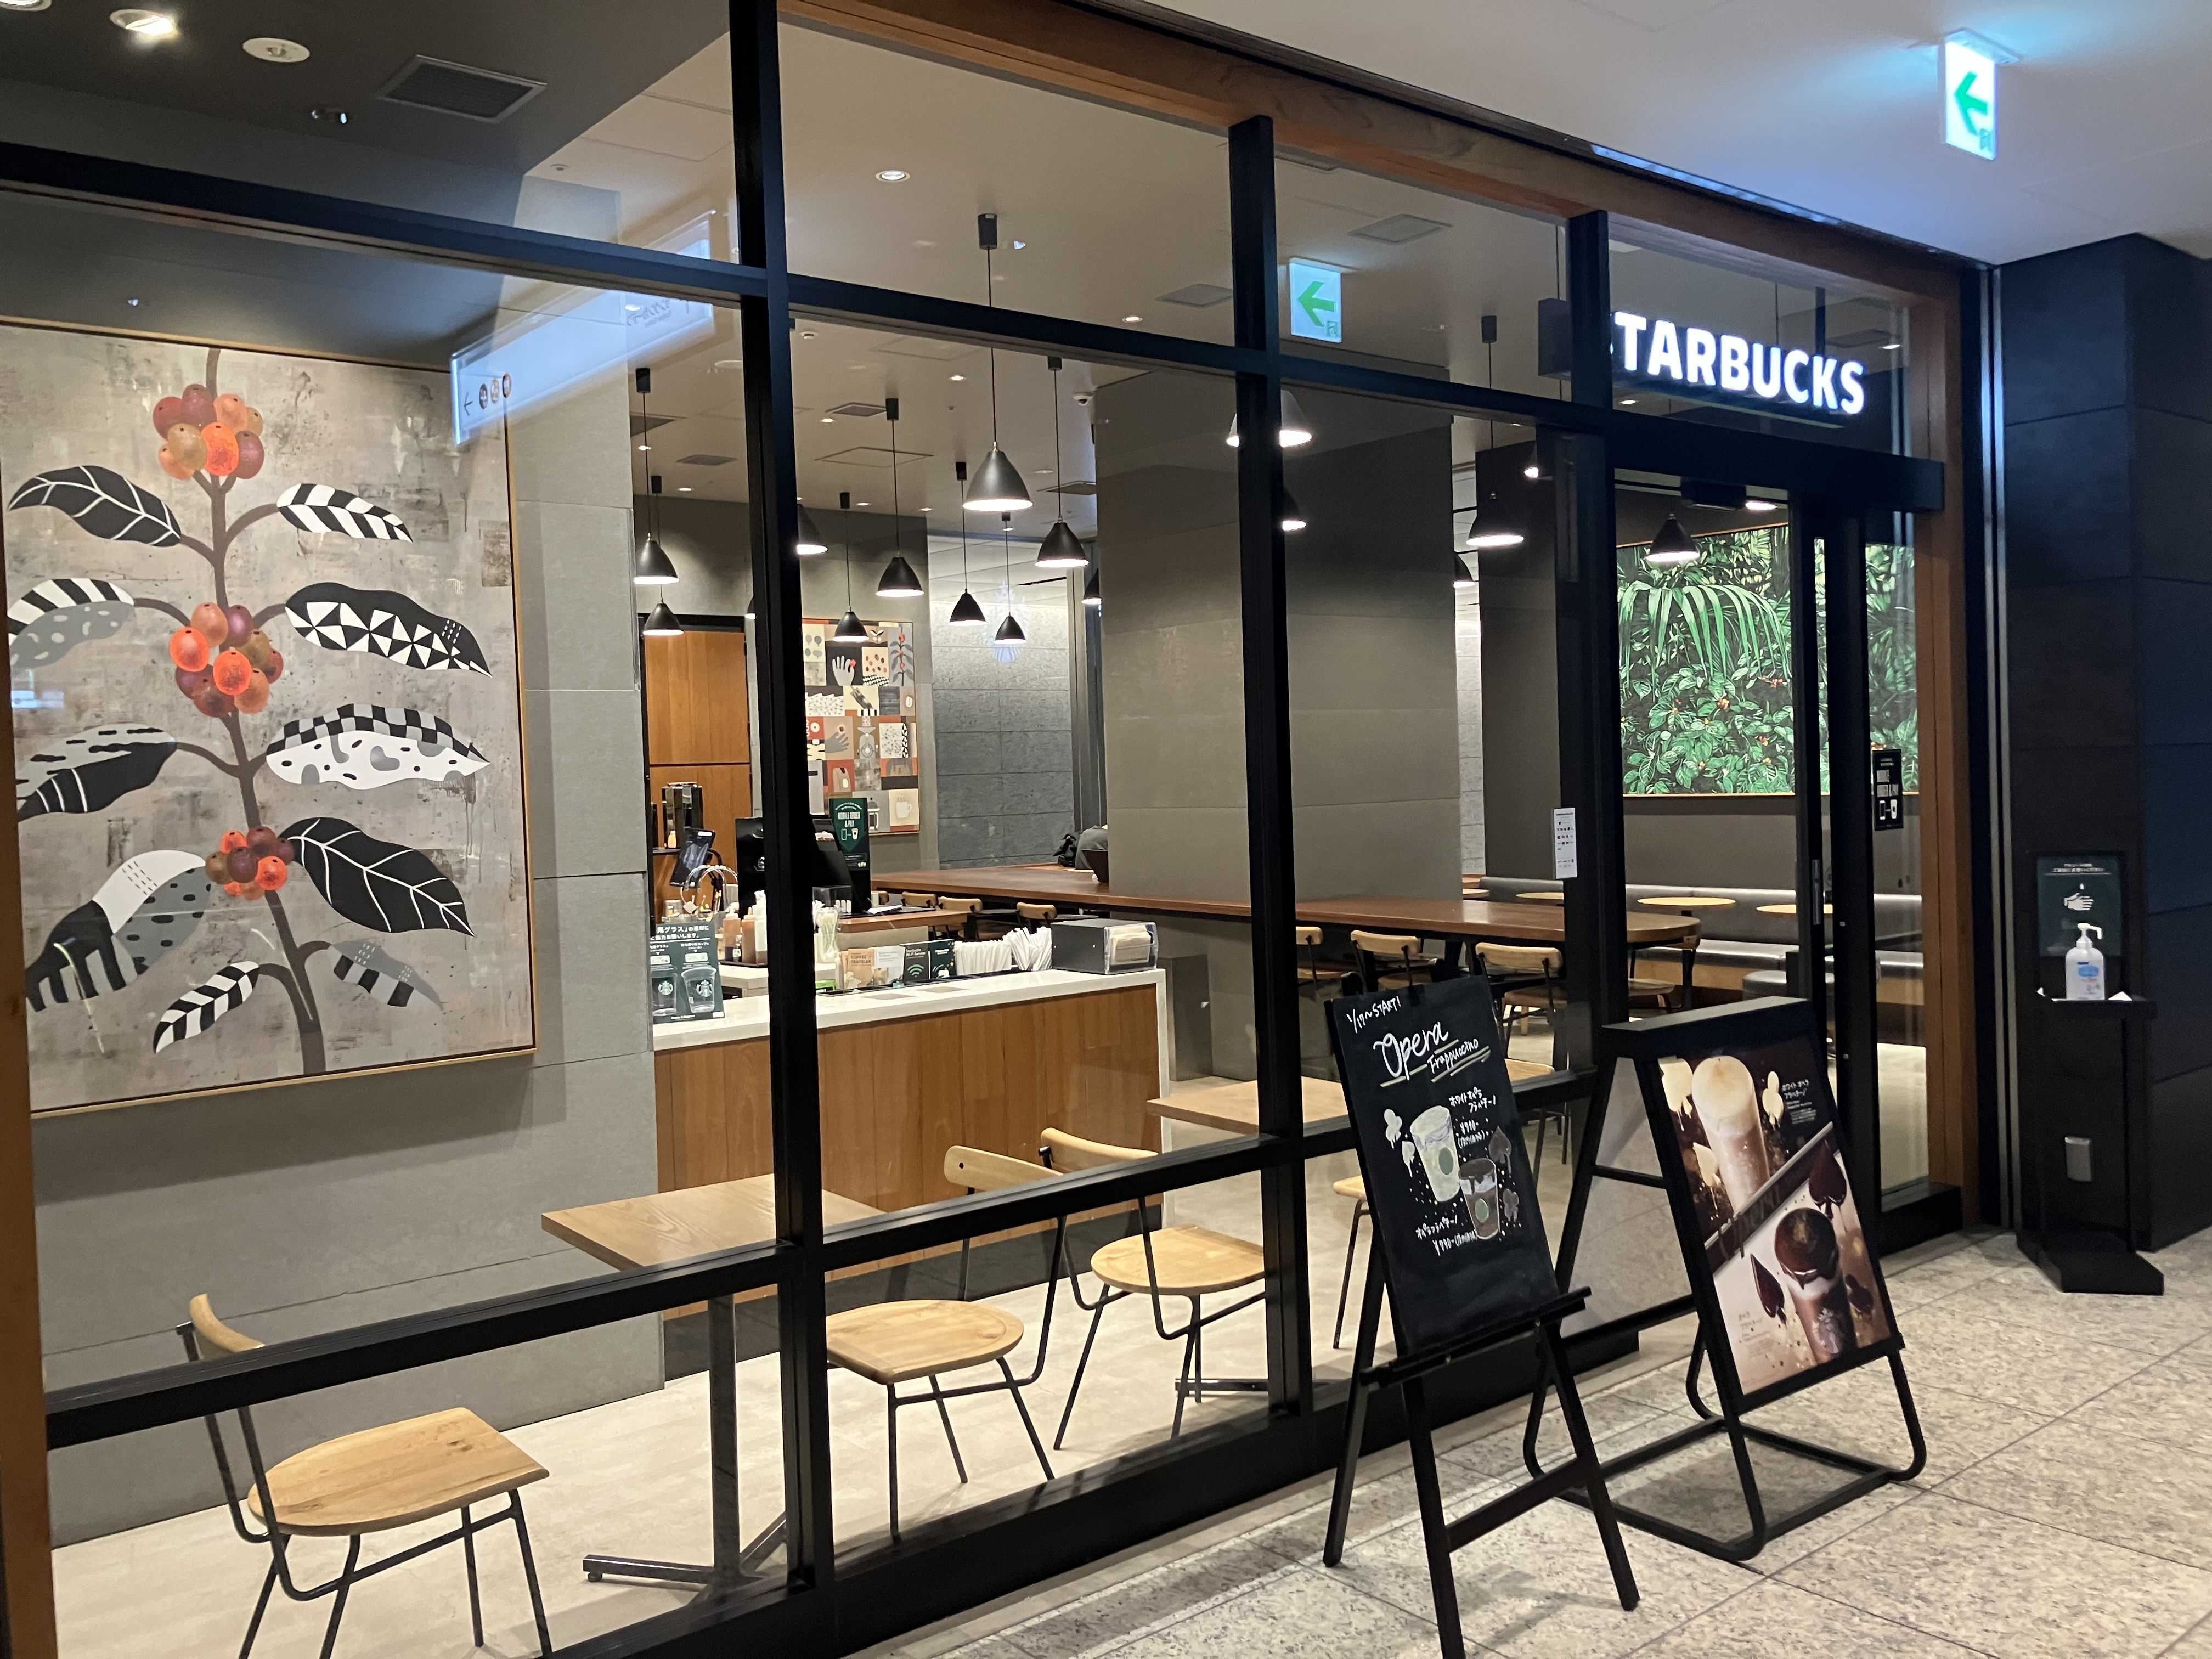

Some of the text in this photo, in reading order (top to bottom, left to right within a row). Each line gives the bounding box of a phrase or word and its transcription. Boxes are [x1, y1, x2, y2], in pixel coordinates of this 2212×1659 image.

[1610, 311, 1865, 415] TARBUCKS
[1373, 1021, 1449, 1081] Opera
[1427, 1038, 1479, 1074] Frappuccino
